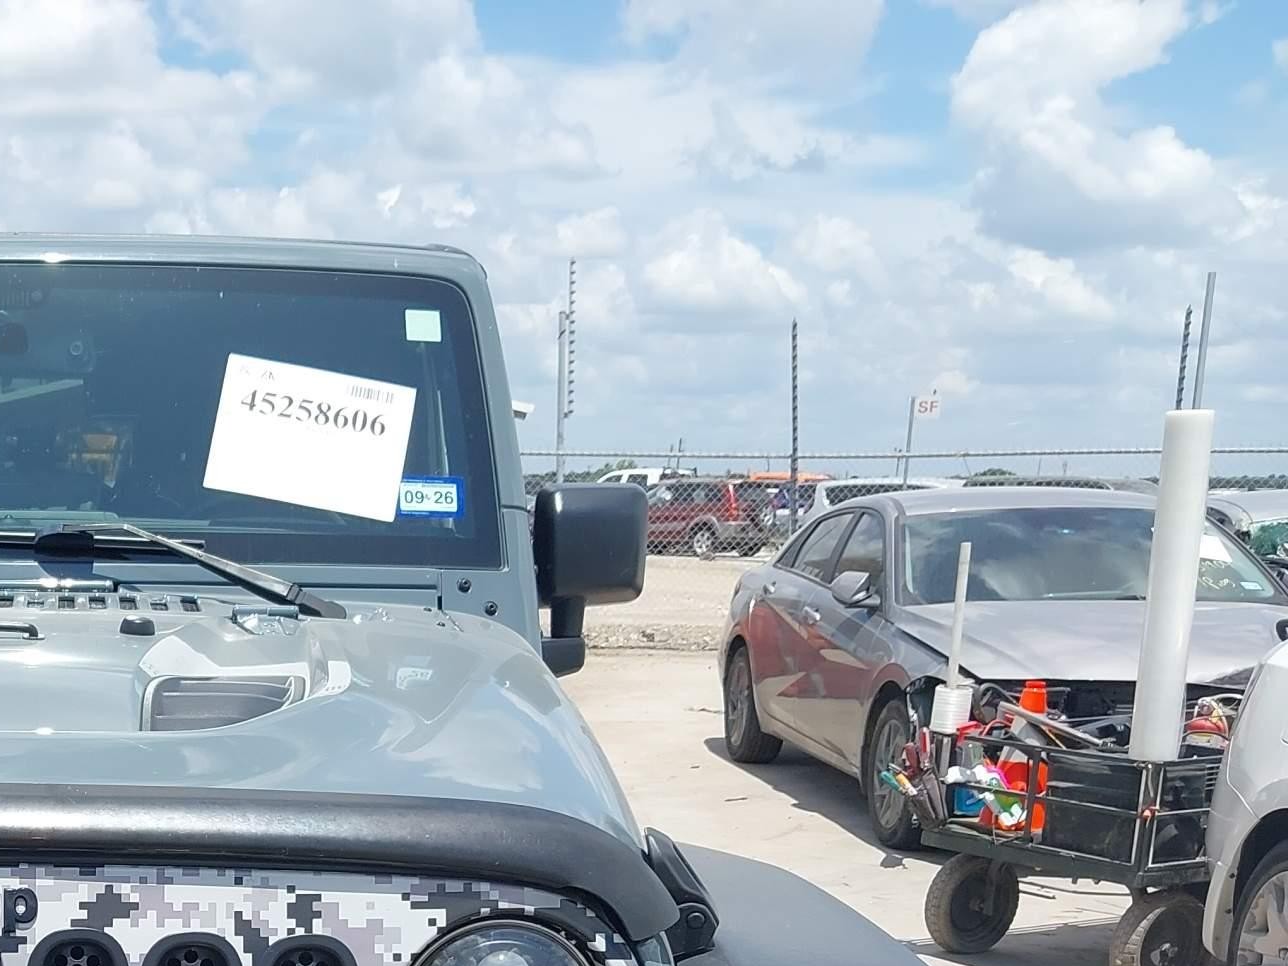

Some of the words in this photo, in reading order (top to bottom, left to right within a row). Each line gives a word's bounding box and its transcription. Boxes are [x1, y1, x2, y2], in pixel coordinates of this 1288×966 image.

[239, 388, 387, 437] 45258606
[917, 400, 939, 414] SF
[404, 490, 424, 504] 09
[433, 490, 454, 505] 26
